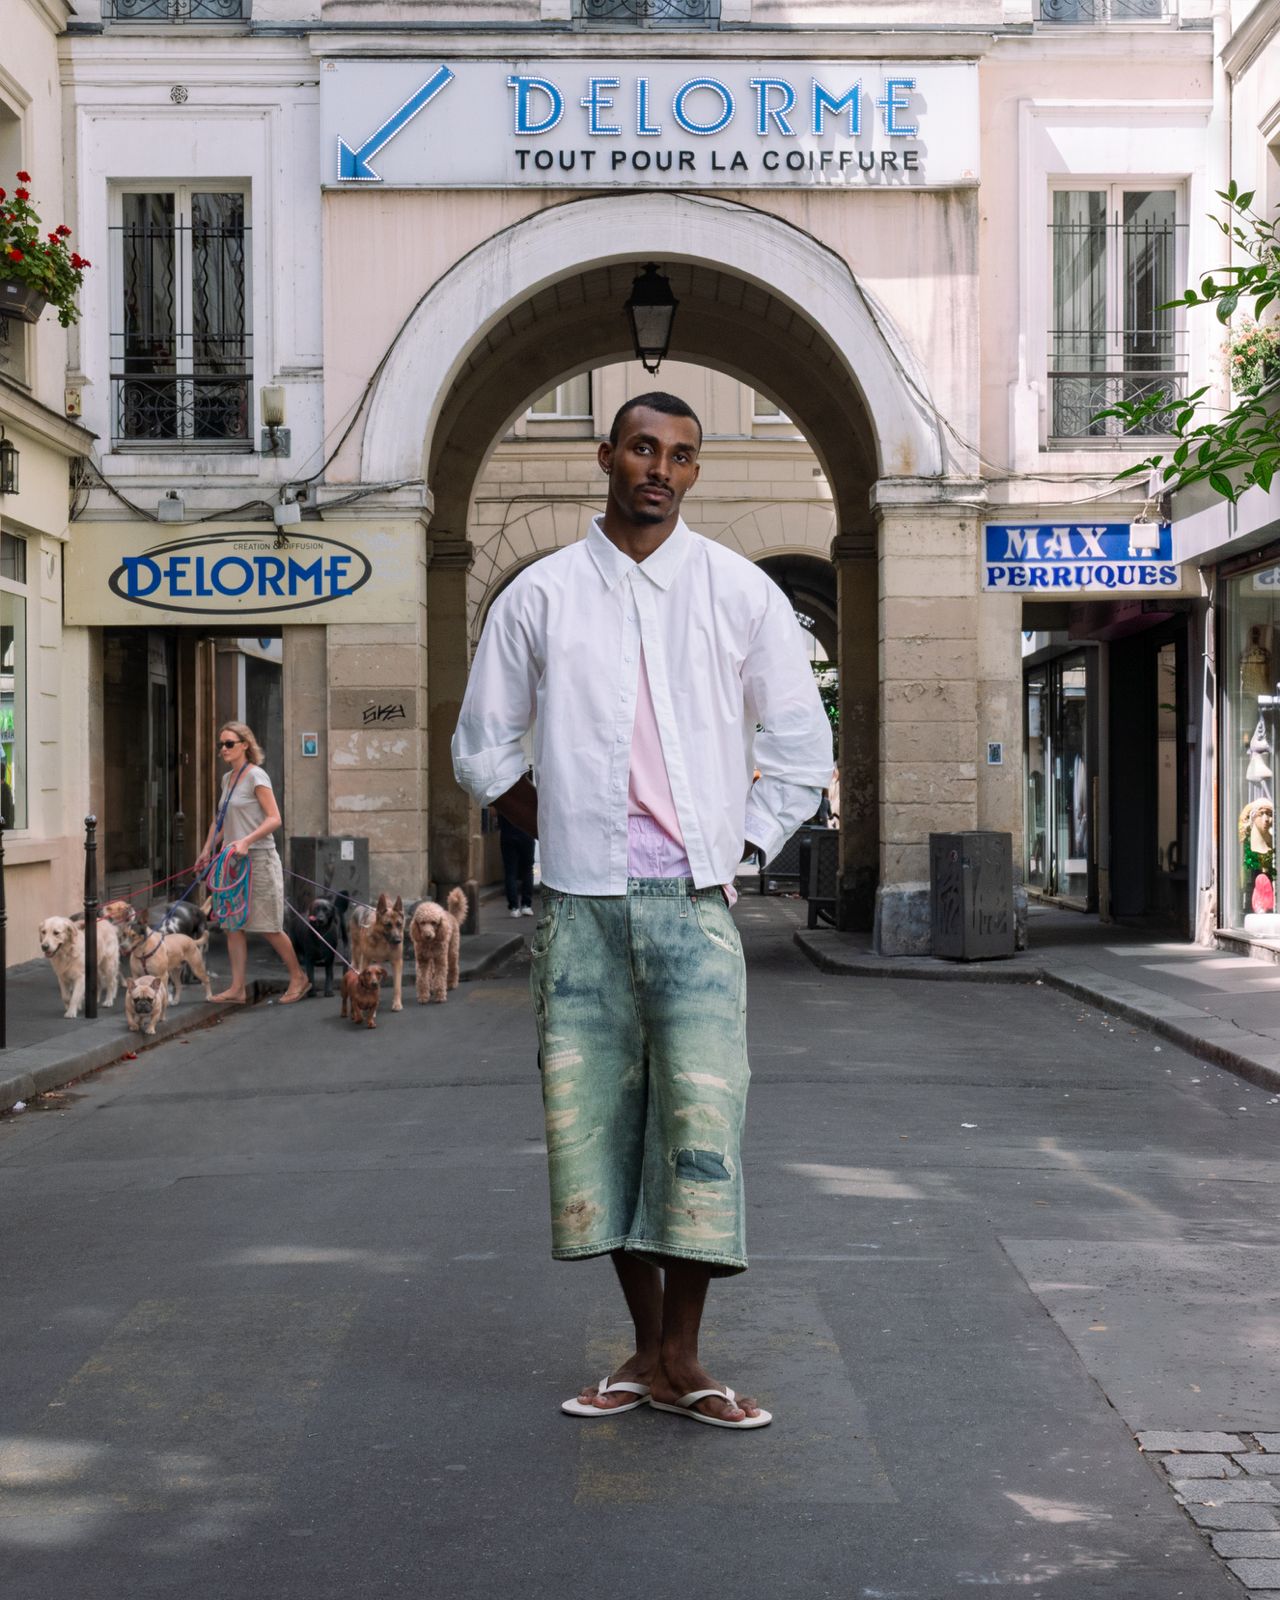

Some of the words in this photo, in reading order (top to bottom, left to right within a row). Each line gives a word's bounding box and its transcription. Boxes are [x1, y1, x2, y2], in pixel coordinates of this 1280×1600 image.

[507, 75, 918, 136] DELORME
[515, 150, 597, 171] TOUT
[611, 150, 697, 171] POUR
[711, 150, 749, 171] LA
[762, 150, 918, 171] COIFFURE
[283, 542, 324, 550] DIFFUSION
[1003, 527, 1107, 559] MAX
[122, 556, 353, 598] DELORME
[987, 565, 1177, 588] PERRUQUES
